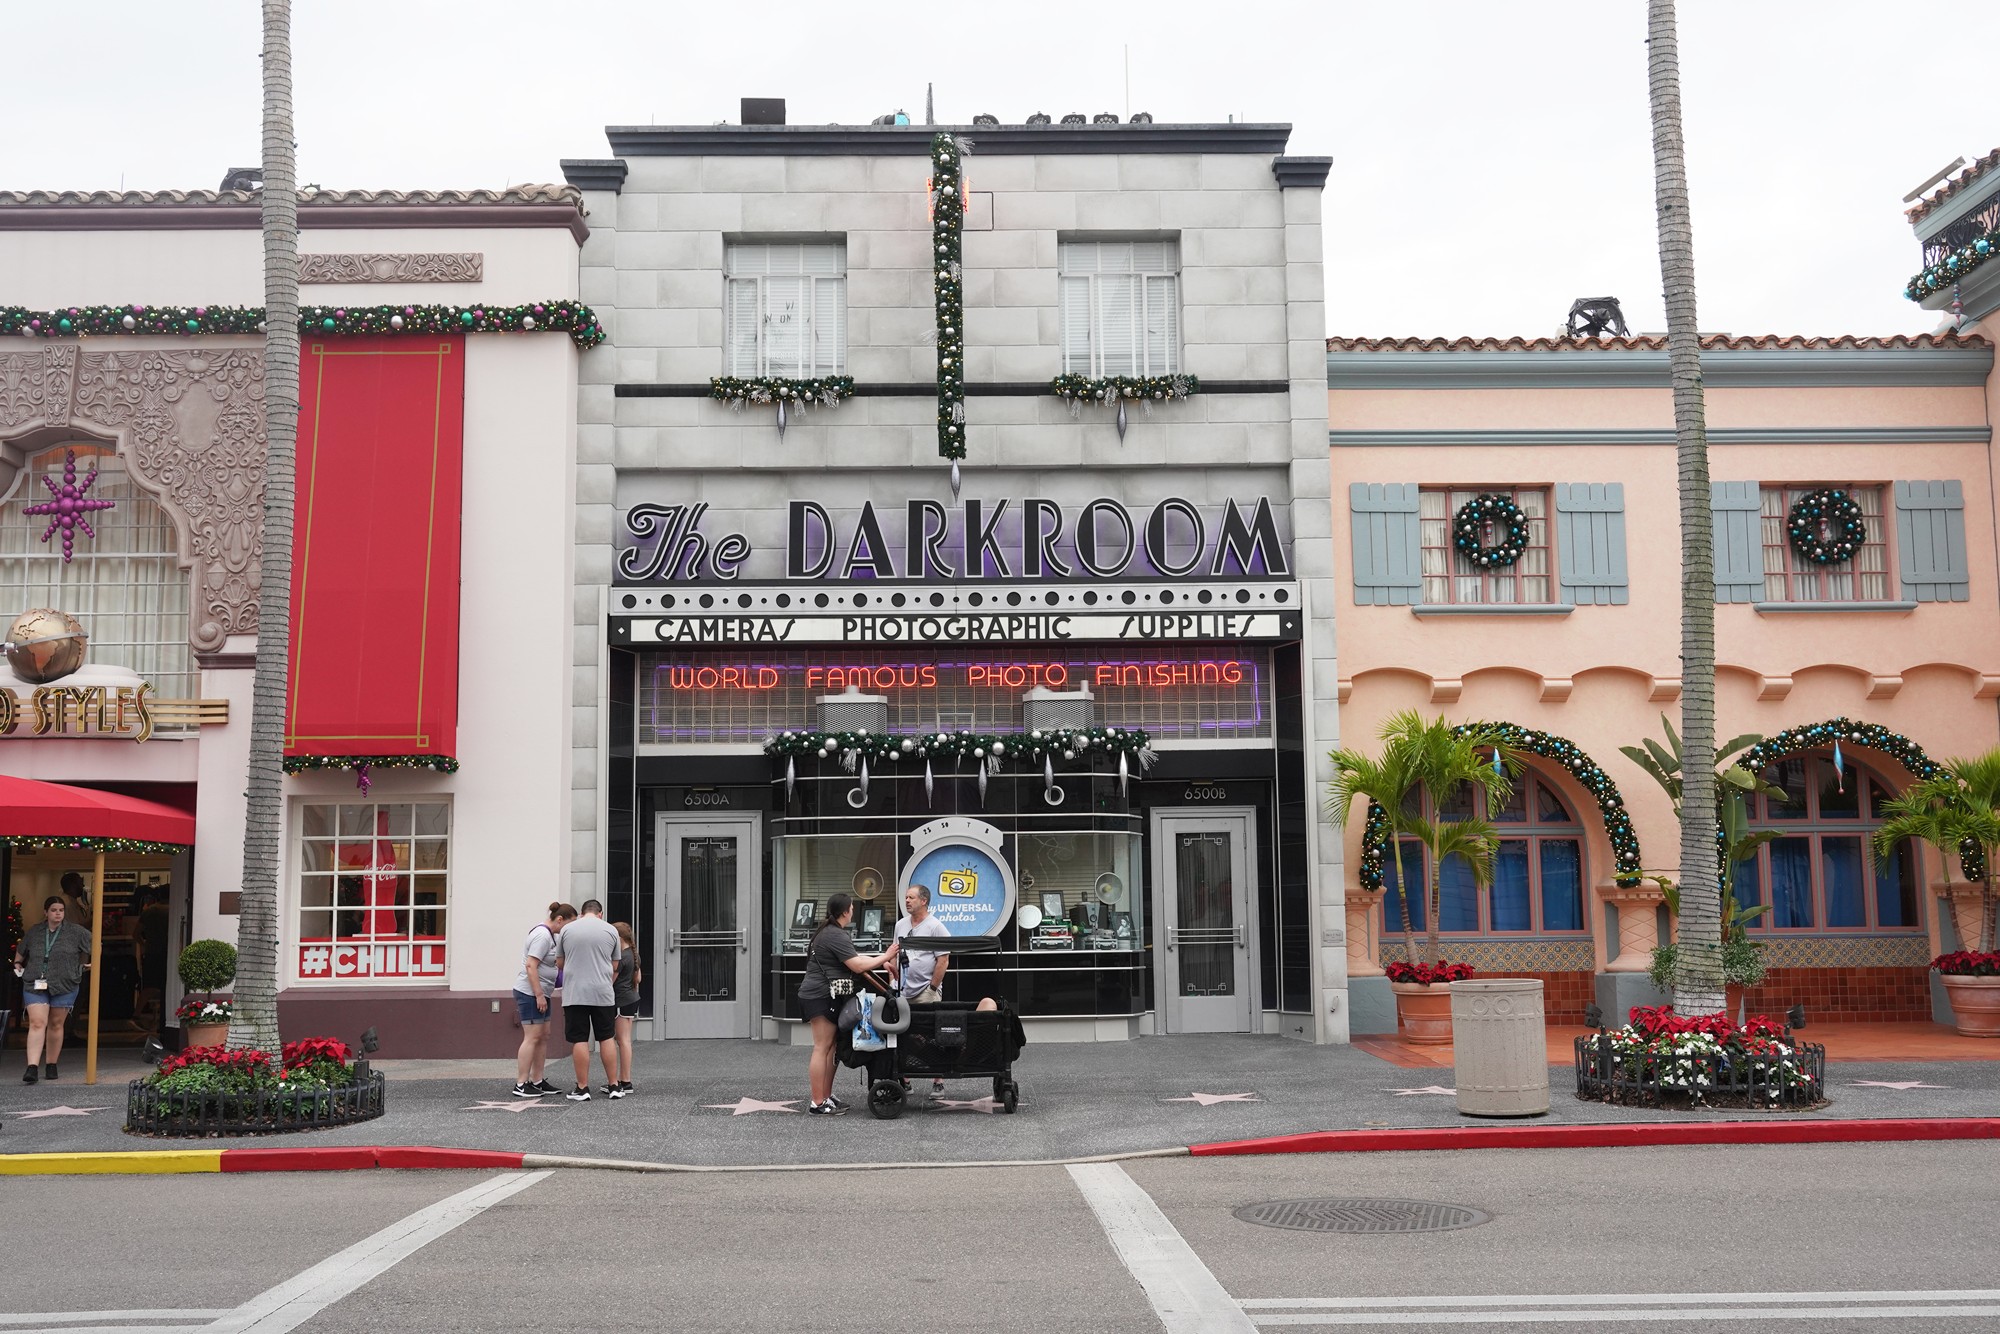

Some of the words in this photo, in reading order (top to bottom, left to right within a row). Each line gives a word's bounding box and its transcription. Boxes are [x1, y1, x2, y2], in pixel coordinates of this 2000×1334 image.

[617, 501, 752, 580] The
[786, 495, 1290, 578] DARKROOM
[655, 618, 796, 642] CAMERAS
[844, 615, 1072, 641] PHOTOGRAPHIC
[1118, 614, 1256, 638] SUPPLIES
[670, 666, 779, 689] WORLD
[807, 666, 938, 689] FAMOUS
[968, 663, 1067, 687] PHOTO
[1096, 661, 1243, 687] FINISHING
[31, 681, 154, 744] STYLES
[684, 793, 730, 806] 6500A
[1184, 787, 1227, 800] 6500B
[363, 864, 397, 881] Coa-Cola
[938, 904, 994, 912] UNIVERSAL
[939, 912, 976, 922] photos
[302, 946, 444, 974] #CHILL
